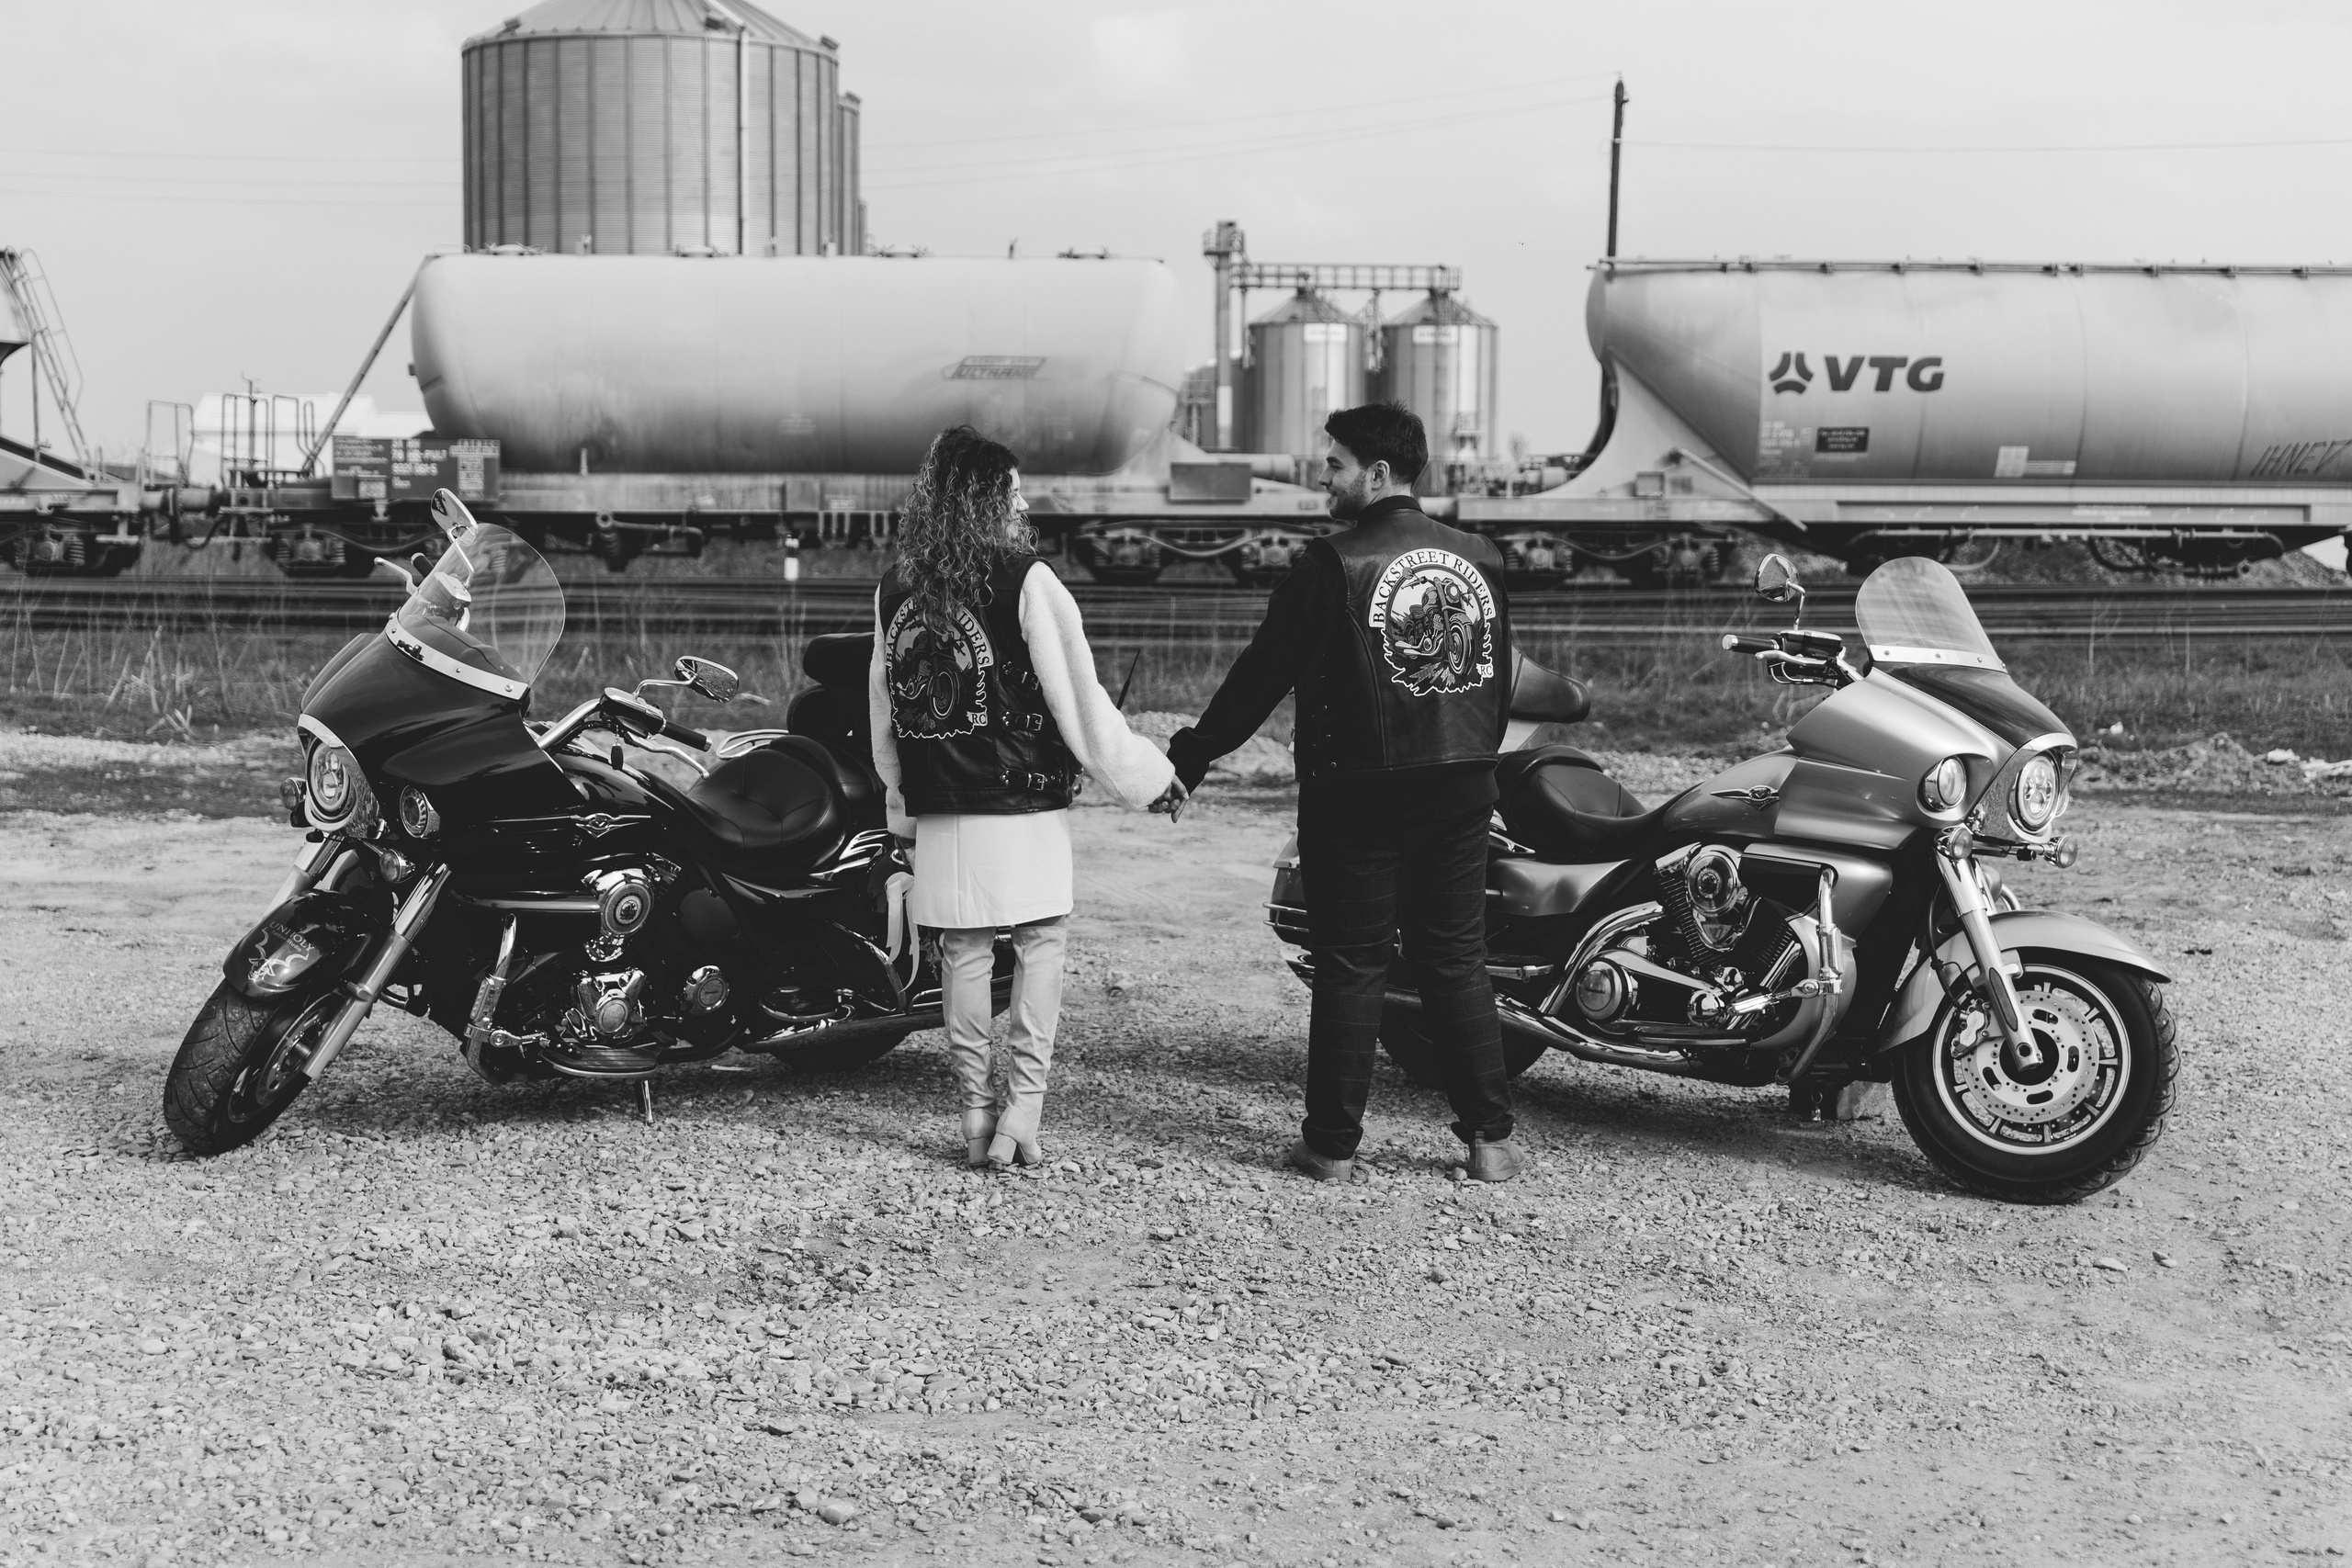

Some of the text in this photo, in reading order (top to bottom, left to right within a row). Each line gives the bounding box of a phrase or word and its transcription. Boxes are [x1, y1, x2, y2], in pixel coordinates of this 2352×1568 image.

[1824, 355, 1944, 392] VTG
[1373, 550, 1493, 624] BACKSTREET RIDERS
[957, 611, 989, 665] IDERS
[1480, 665, 1492, 676] RC
[972, 714, 987, 725] RC
[269, 921, 316, 952] UNHOLY
[286, 938, 302, 953] Studio
